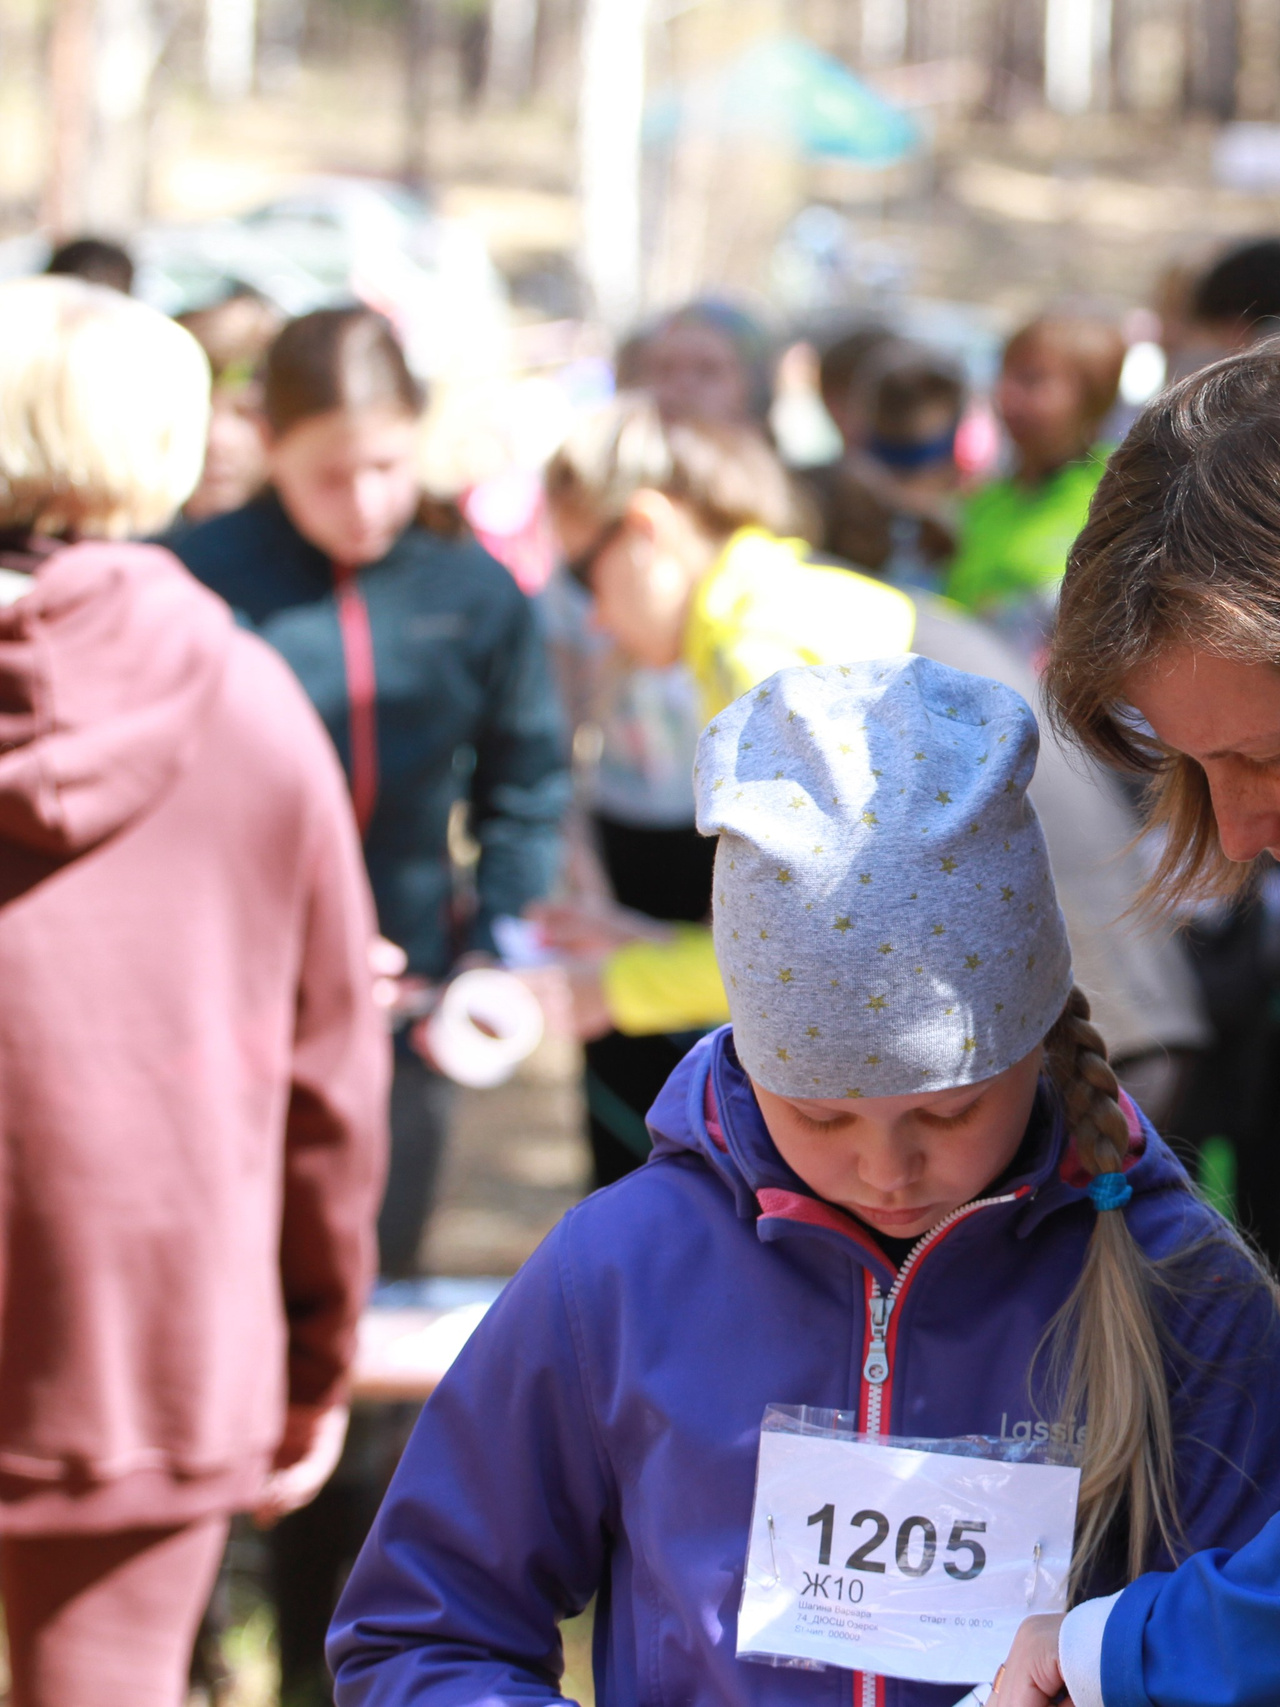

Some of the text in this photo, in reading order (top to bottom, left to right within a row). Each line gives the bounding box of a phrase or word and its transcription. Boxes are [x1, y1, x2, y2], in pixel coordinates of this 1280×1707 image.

[1001, 1412, 1087, 1444] Lassie
[806, 1503, 987, 1581] 1205
[801, 1571, 864, 1603] Ж10
[798, 1600, 872, 1619] Шагина Варвара
[954, 1616, 994, 1628] 000000
[846, 1619, 879, 1632] Озерск
